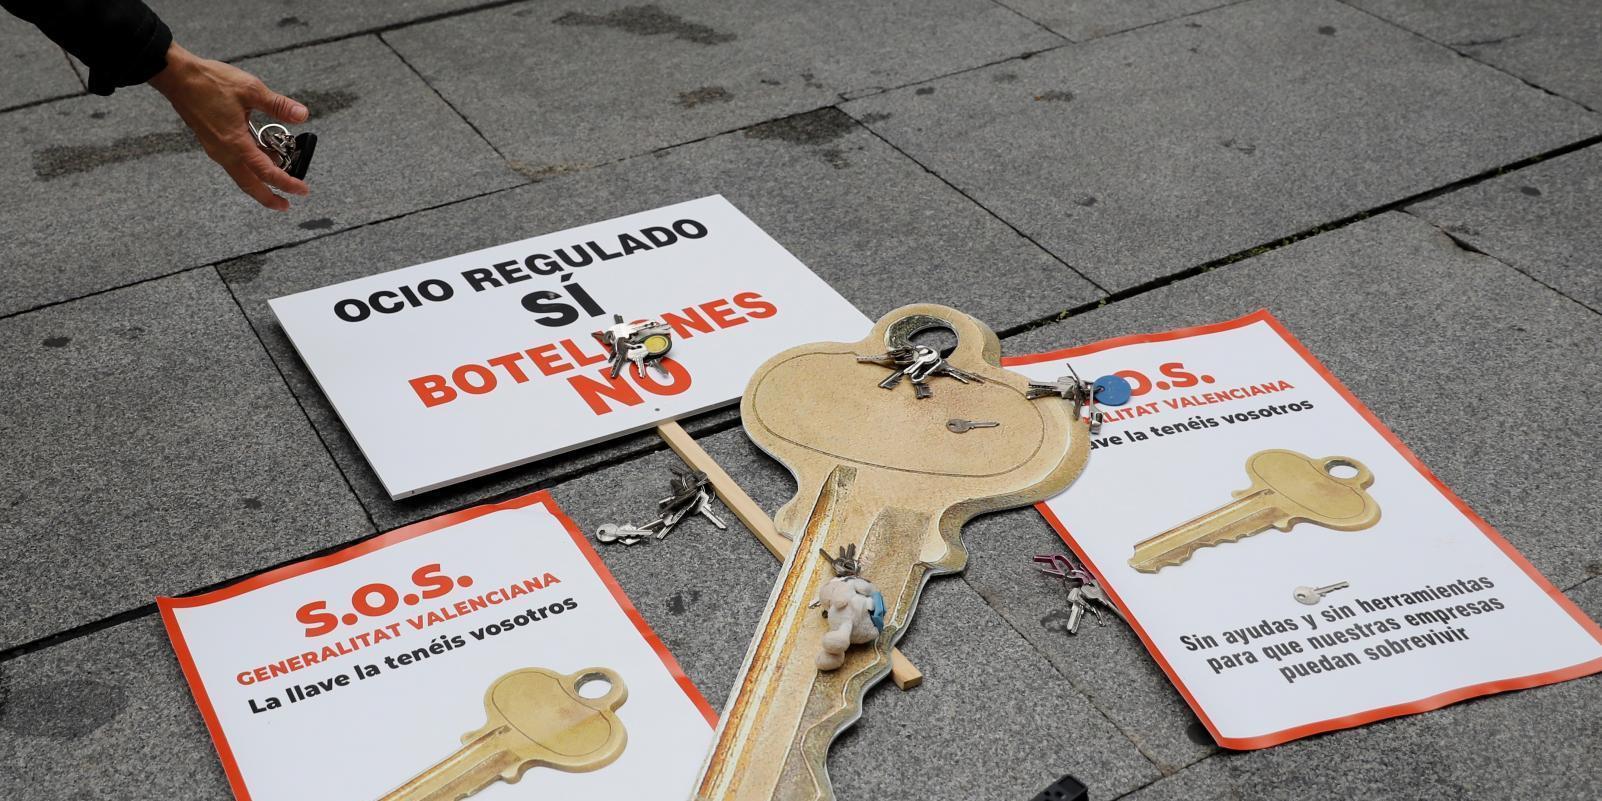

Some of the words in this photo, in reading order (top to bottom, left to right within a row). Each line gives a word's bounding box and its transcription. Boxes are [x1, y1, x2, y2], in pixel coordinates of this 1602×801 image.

[334, 279, 454, 322] OCIO
[461, 219, 708, 292] REGULADO
[521, 272, 606, 327] SÍ
[408, 292, 777, 408] BOTELNES
[566, 356, 692, 416] NO
[1124, 431, 1149, 442] la
[1150, 415, 1220, 437] tenéis
[1220, 400, 1314, 424] vosotros
[1163, 380, 1294, 409] VALENCIANA
[236, 623, 401, 686] GENERALITAT
[406, 572, 561, 631] VALENCIANA
[296, 563, 473, 637] S.O.S.
[1179, 634, 1219, 652] Sin
[1222, 614, 1299, 646] ayudas
[1300, 614, 1317, 631] y
[1321, 605, 1356, 624] sin
[1355, 574, 1495, 614] herramientas
[1206, 653, 1258, 675] para
[1262, 641, 1304, 662] que
[1307, 615, 1401, 650] nuestras
[1404, 595, 1505, 627] empresas
[248, 694, 282, 714] La
[285, 673, 351, 703] llave
[354, 662, 381, 681] la
[384, 633, 467, 671] tenéis
[469, 597, 578, 641] vosotros
[1279, 649, 1361, 684] puedan
[1363, 625, 1470, 661] sobrevivir
